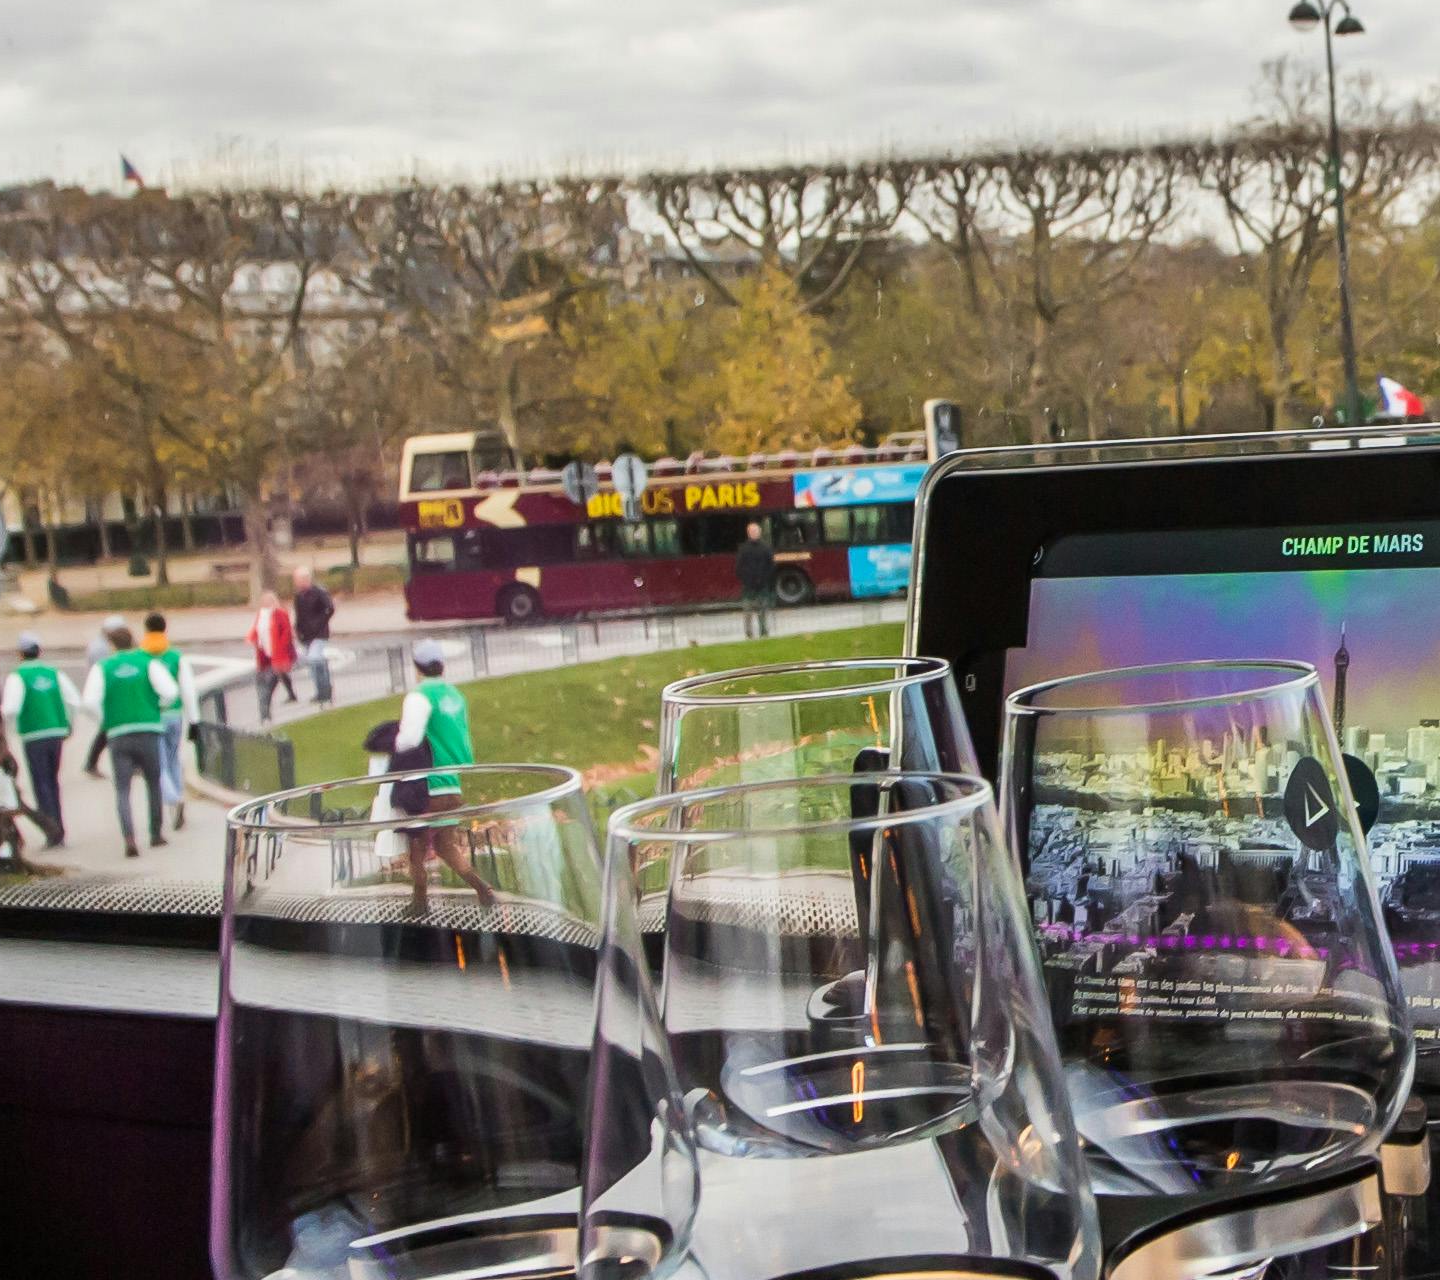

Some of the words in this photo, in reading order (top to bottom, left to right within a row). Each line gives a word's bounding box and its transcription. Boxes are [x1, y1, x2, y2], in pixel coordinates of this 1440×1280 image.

[684, 481, 761, 511] PARIS
[1282, 536, 1343, 556] CHAMP
[1347, 535, 1370, 554] DE
[1373, 533, 1424, 553] MARS
[1412, 995, 1431, 1007] plus
